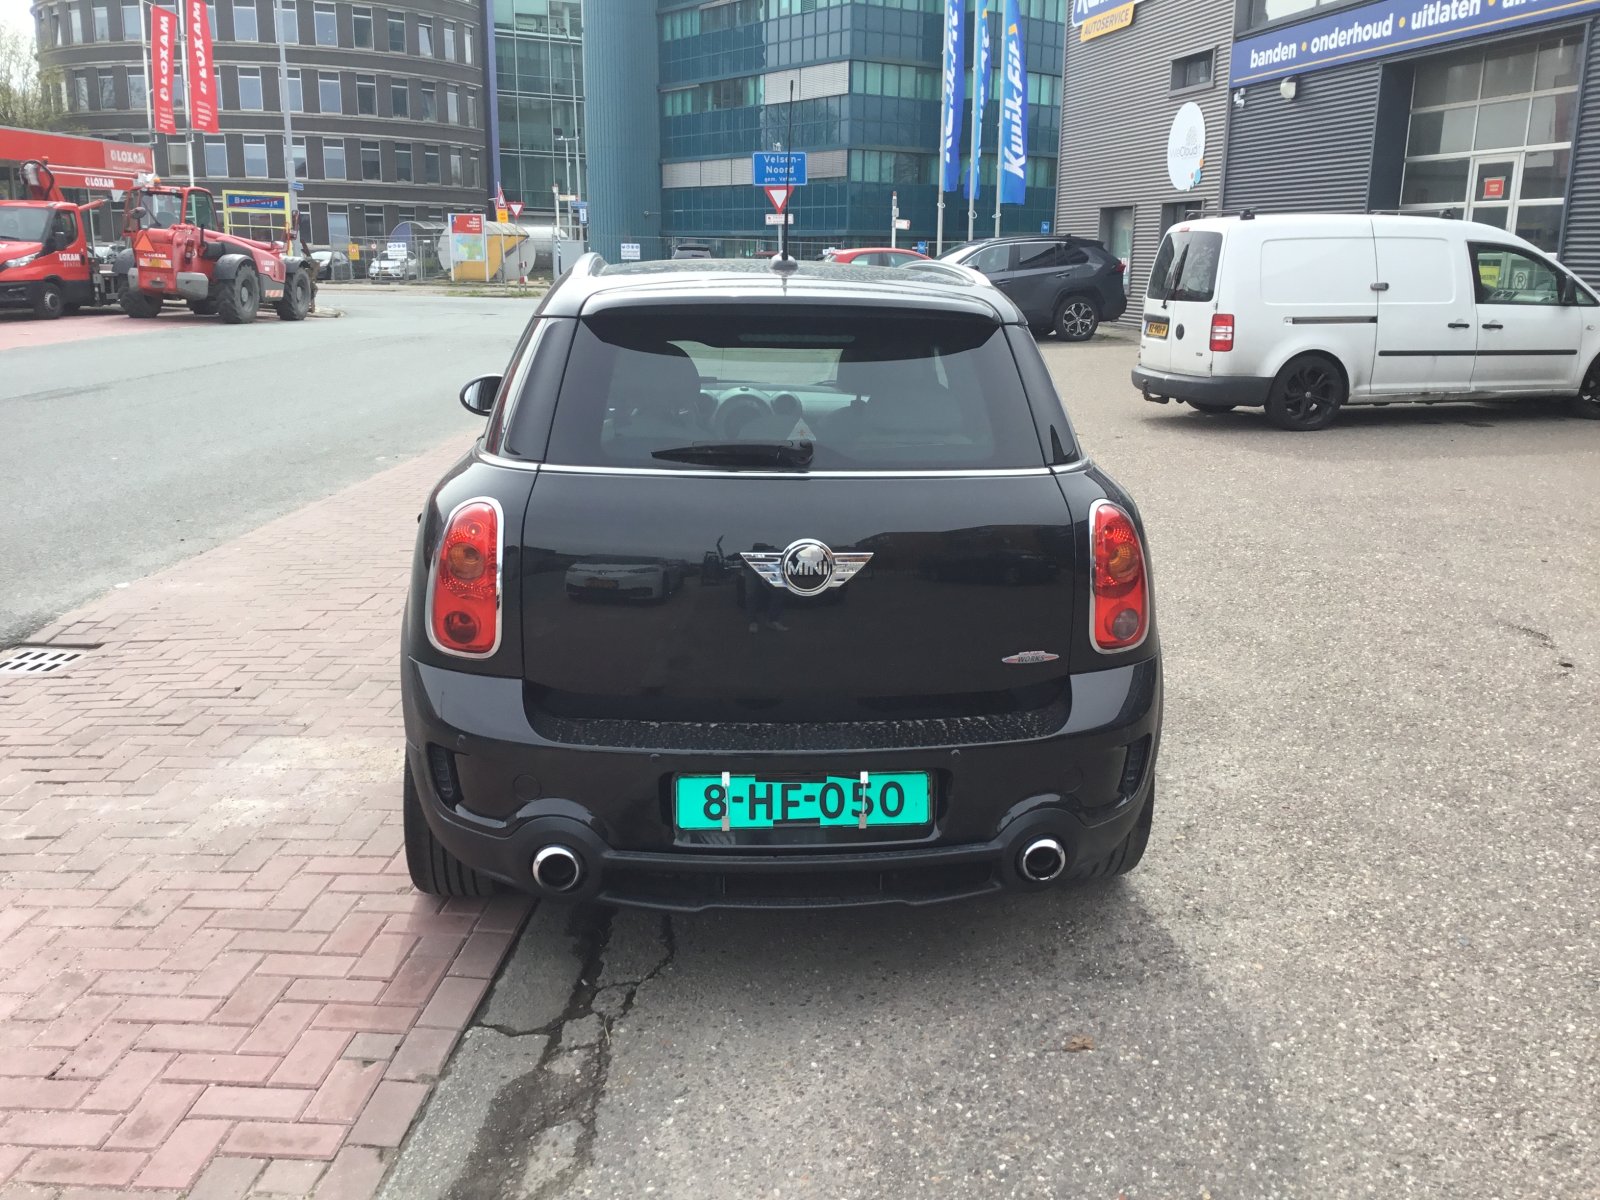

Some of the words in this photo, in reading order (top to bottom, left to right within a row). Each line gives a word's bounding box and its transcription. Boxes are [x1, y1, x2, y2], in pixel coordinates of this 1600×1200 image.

[1084, 8, 1131, 35] AUTOSERVICE
[192, 2, 208, 79] LOXAM
[1249, 41, 1298, 69] banden
[1310, 14, 1393, 54] onderhoud
[1411, 0, 1481, 31] uitlaten
[160, 15, 169, 86] LOXAM
[117, 150, 146, 164] LOXAM
[763, 155, 802, 163] Velsen-
[765, 165, 795, 174] Noord
[90, 177, 115, 188] LOXAM
[58, 253, 81, 262] LOXAM
[787, 560, 828, 576] MINI
[1017, 655, 1046, 663] WORKS
[703, 780, 905, 821] 8-HF-050
